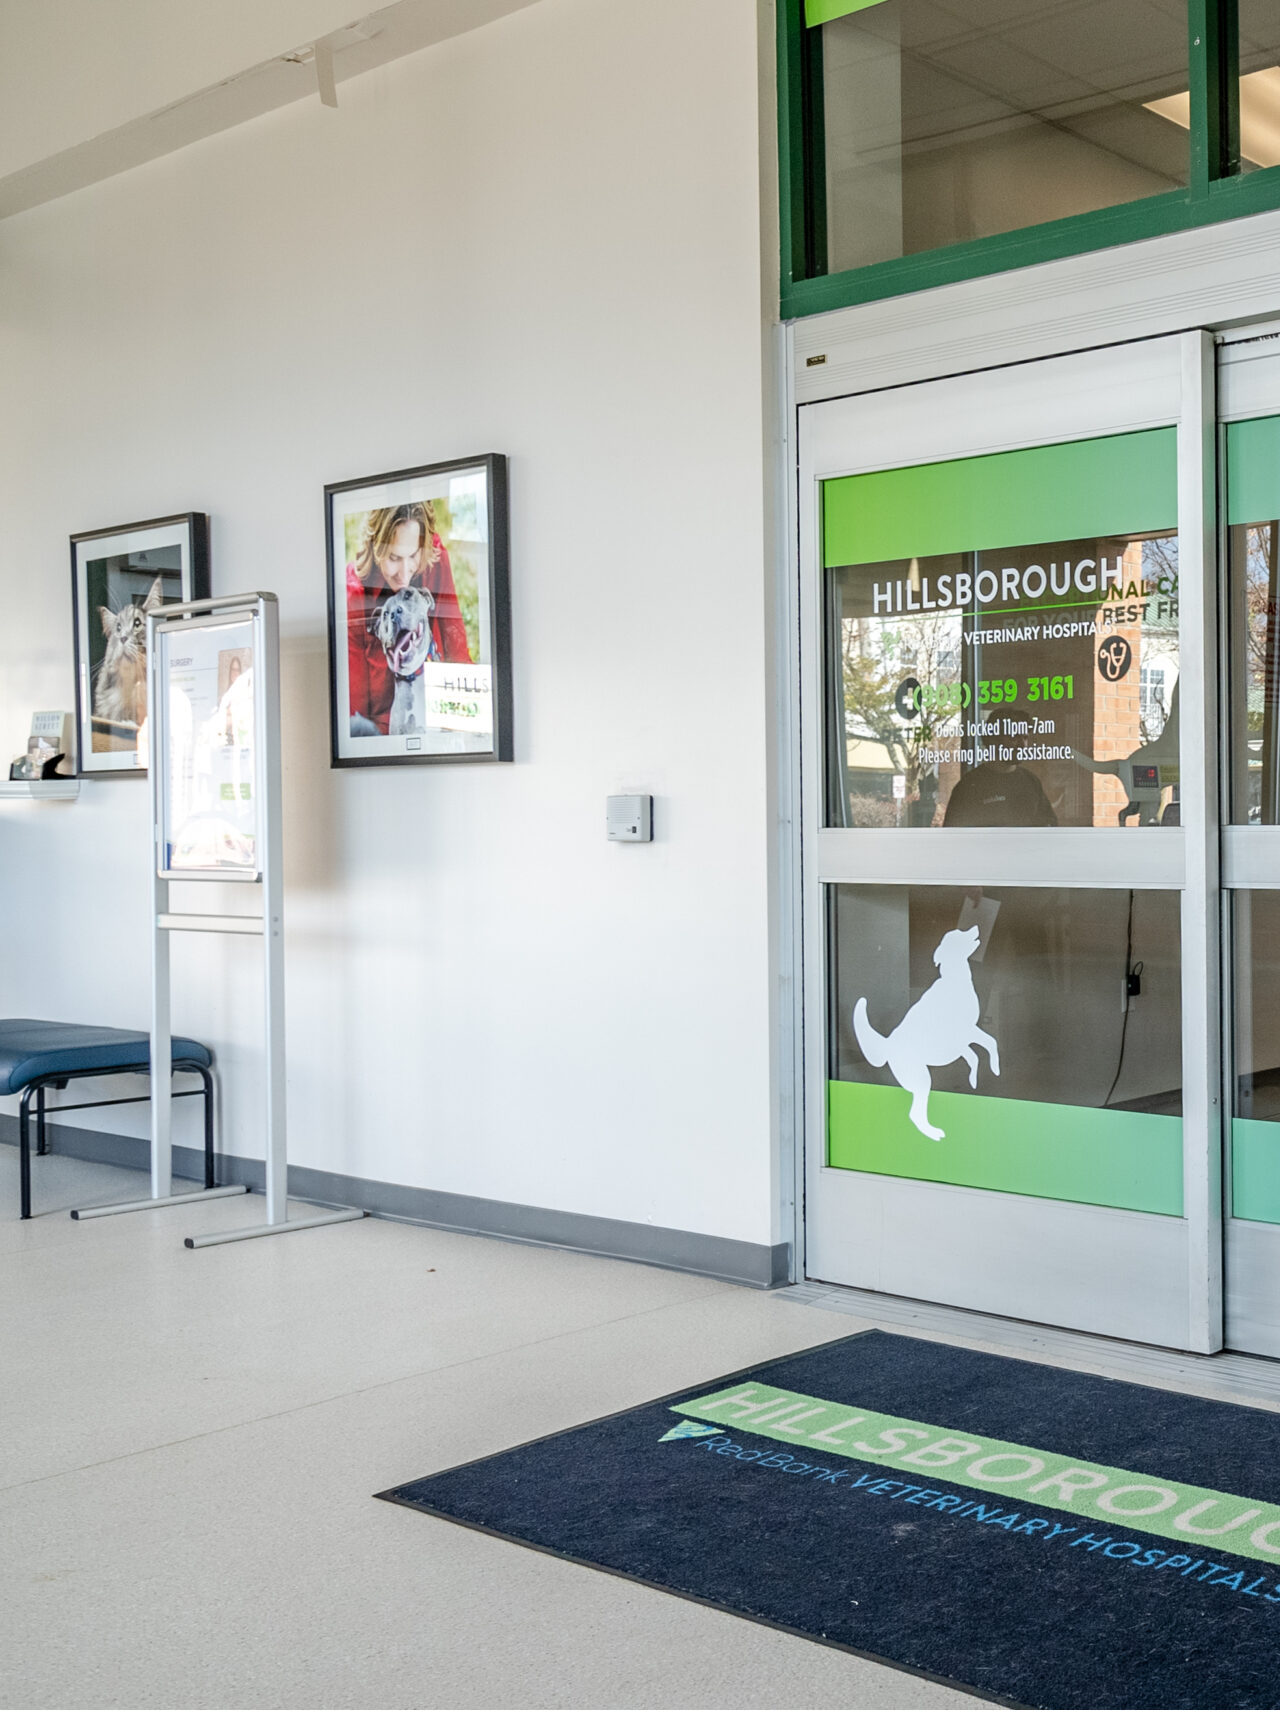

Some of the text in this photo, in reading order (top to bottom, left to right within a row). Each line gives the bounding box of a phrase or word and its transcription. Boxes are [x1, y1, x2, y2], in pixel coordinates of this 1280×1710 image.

[872, 555, 1124, 614] HILLSBOROUGH
[963, 624, 1040, 646] VETERINARY
[1042, 620, 1113, 639] HOSPITALS
[977, 679, 1018, 704] 359
[1026, 675, 1074, 701] 3161
[967, 721, 1000, 737] locked
[1003, 717, 1055, 738] 11pm-7am
[919, 744, 1075, 765] Please ring bell for assistance.
[695, 1435, 850, 1484] RedBank
[851, 1474, 1076, 1541] VETERINARY
